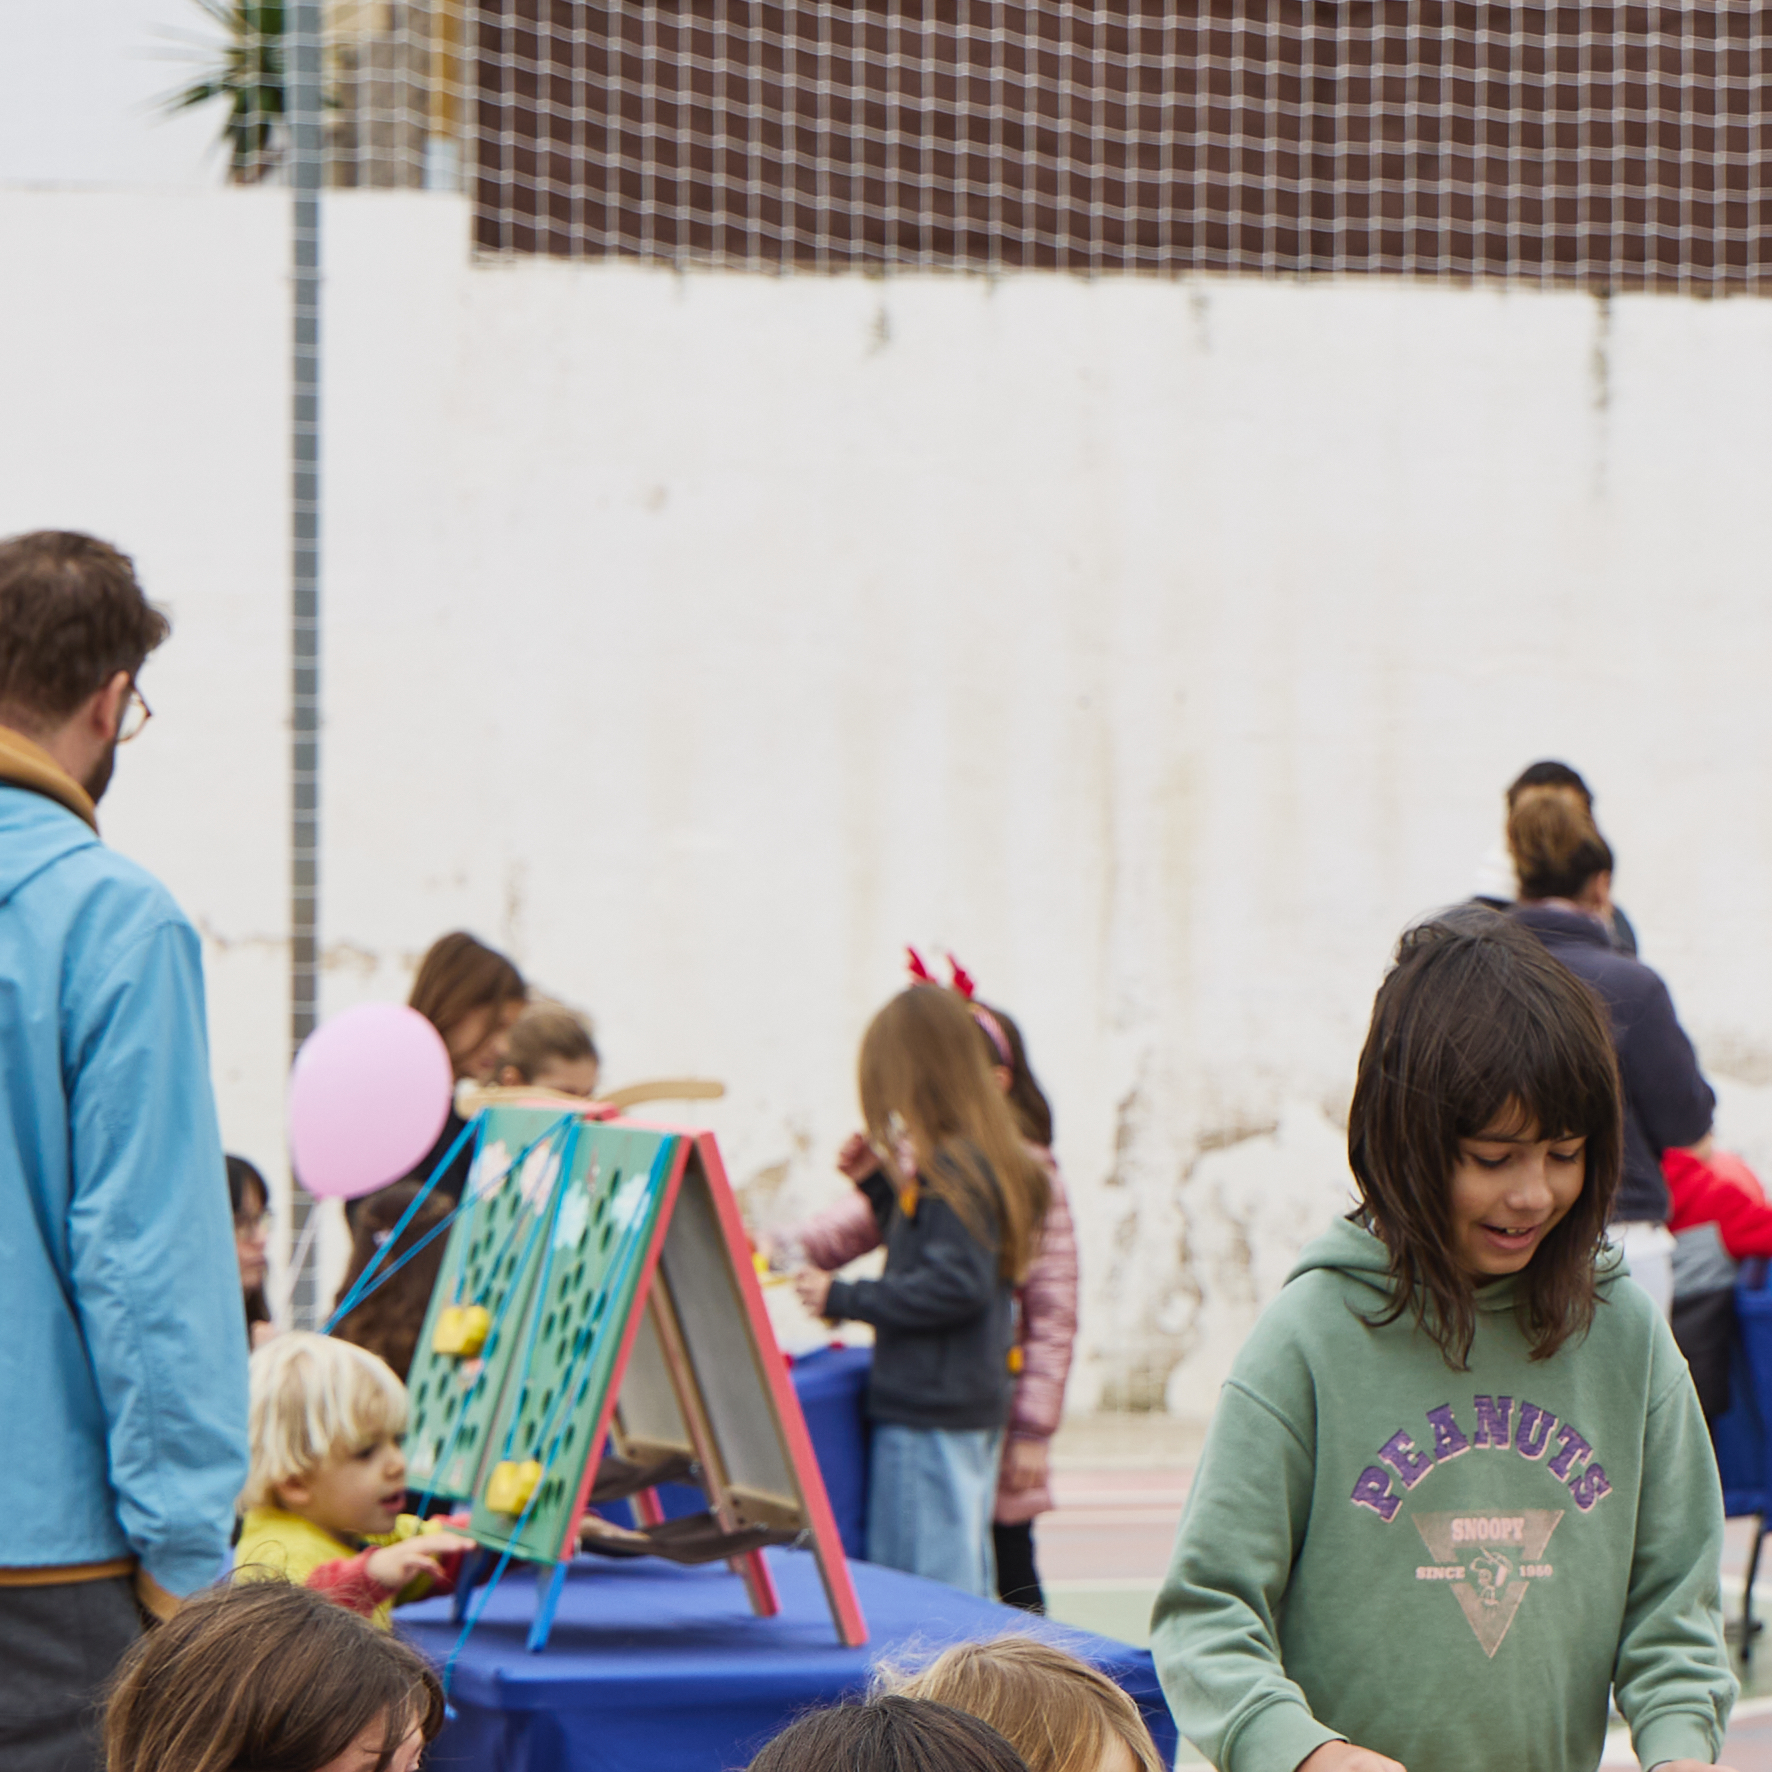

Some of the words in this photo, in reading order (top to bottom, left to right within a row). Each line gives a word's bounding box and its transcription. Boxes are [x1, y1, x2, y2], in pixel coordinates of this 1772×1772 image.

[1350, 1394, 1613, 1523] PEANUTS
[1451, 1517, 1525, 1541] SNOOPY
[1415, 1565, 1466, 1580] SINCE
